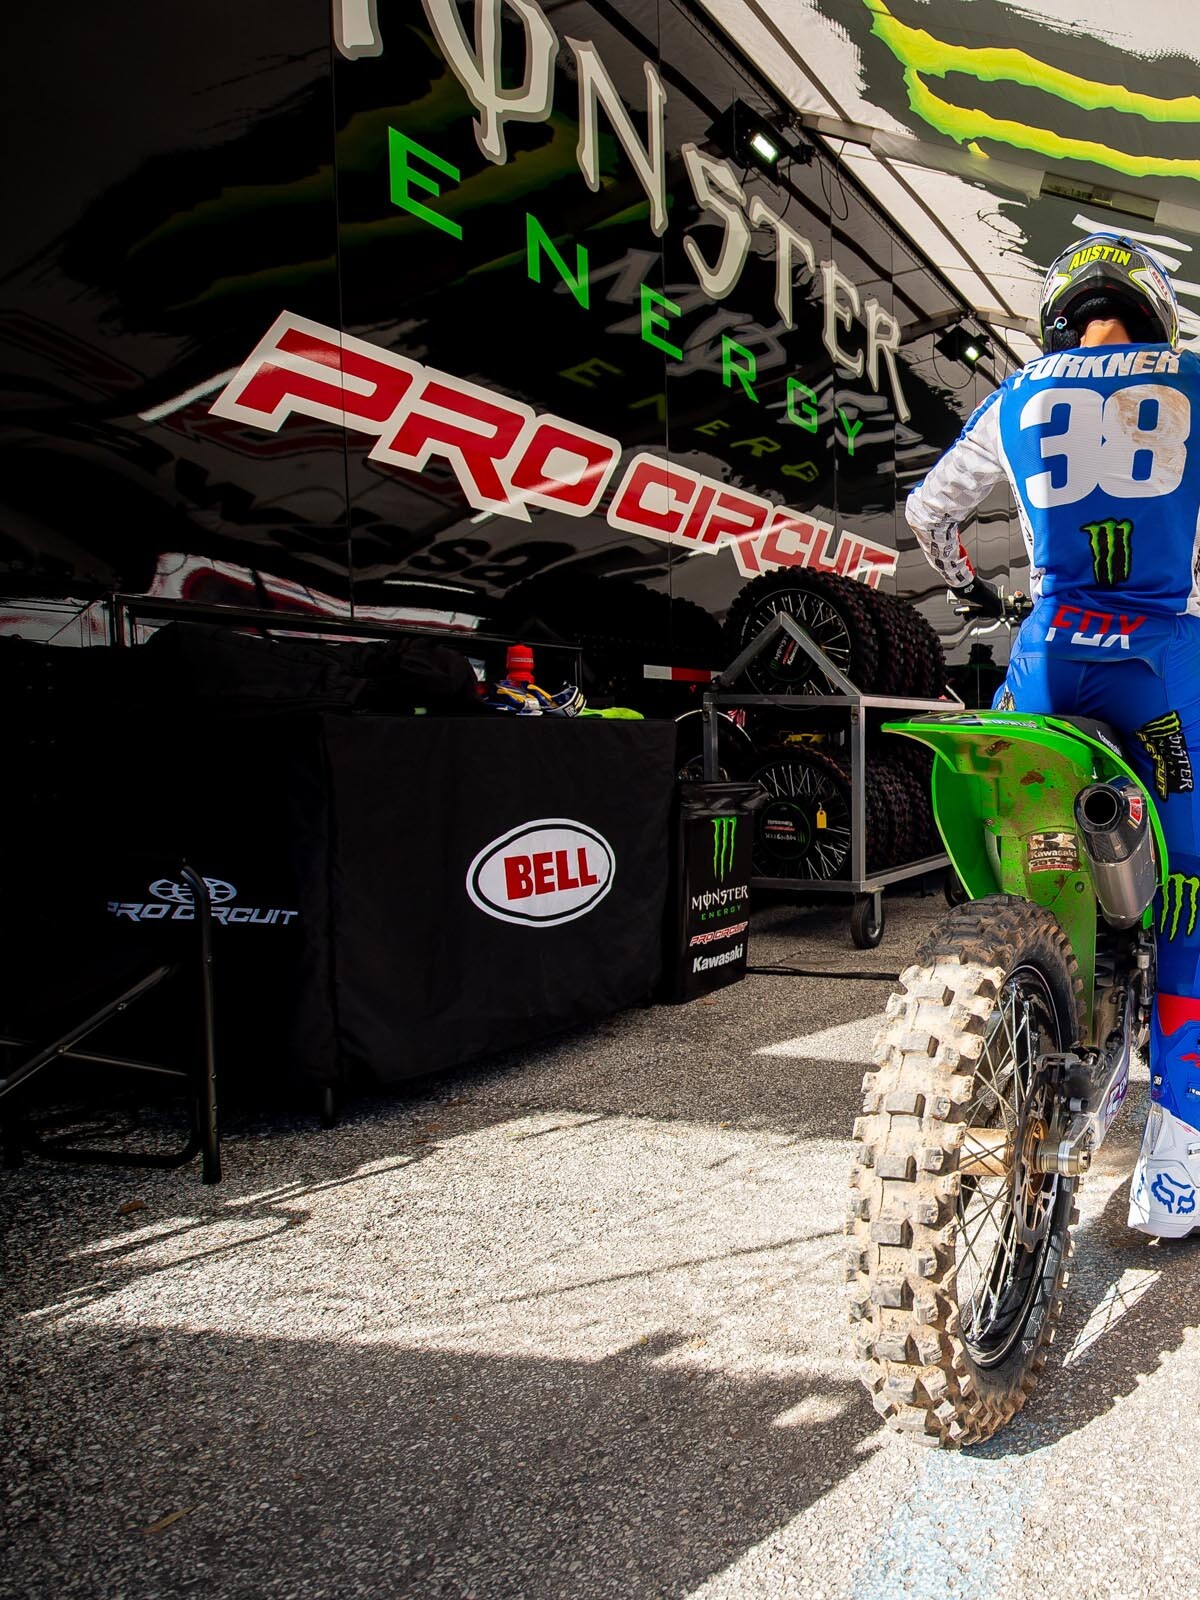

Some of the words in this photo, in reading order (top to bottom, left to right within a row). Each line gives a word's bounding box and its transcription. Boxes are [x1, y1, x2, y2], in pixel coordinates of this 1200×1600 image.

[332, 0, 912, 422] ONSTER
[1068, 245, 1132, 272] AUSTIN
[388, 126, 864, 456] ENERGY
[1014, 349, 1181, 390] FORKNER
[208, 310, 622, 523] PRO
[606, 452, 900, 590] CIRCUIT
[1019, 384, 1191, 509] 38
[1045, 605, 1147, 649] FOX
[504, 847, 598, 900] BELL
[171, 902, 299, 925] CRCUIT
[691, 885, 749, 911] MONSTER
[689, 931, 715, 947] PRO
[692, 943, 744, 974] Kawasaki
